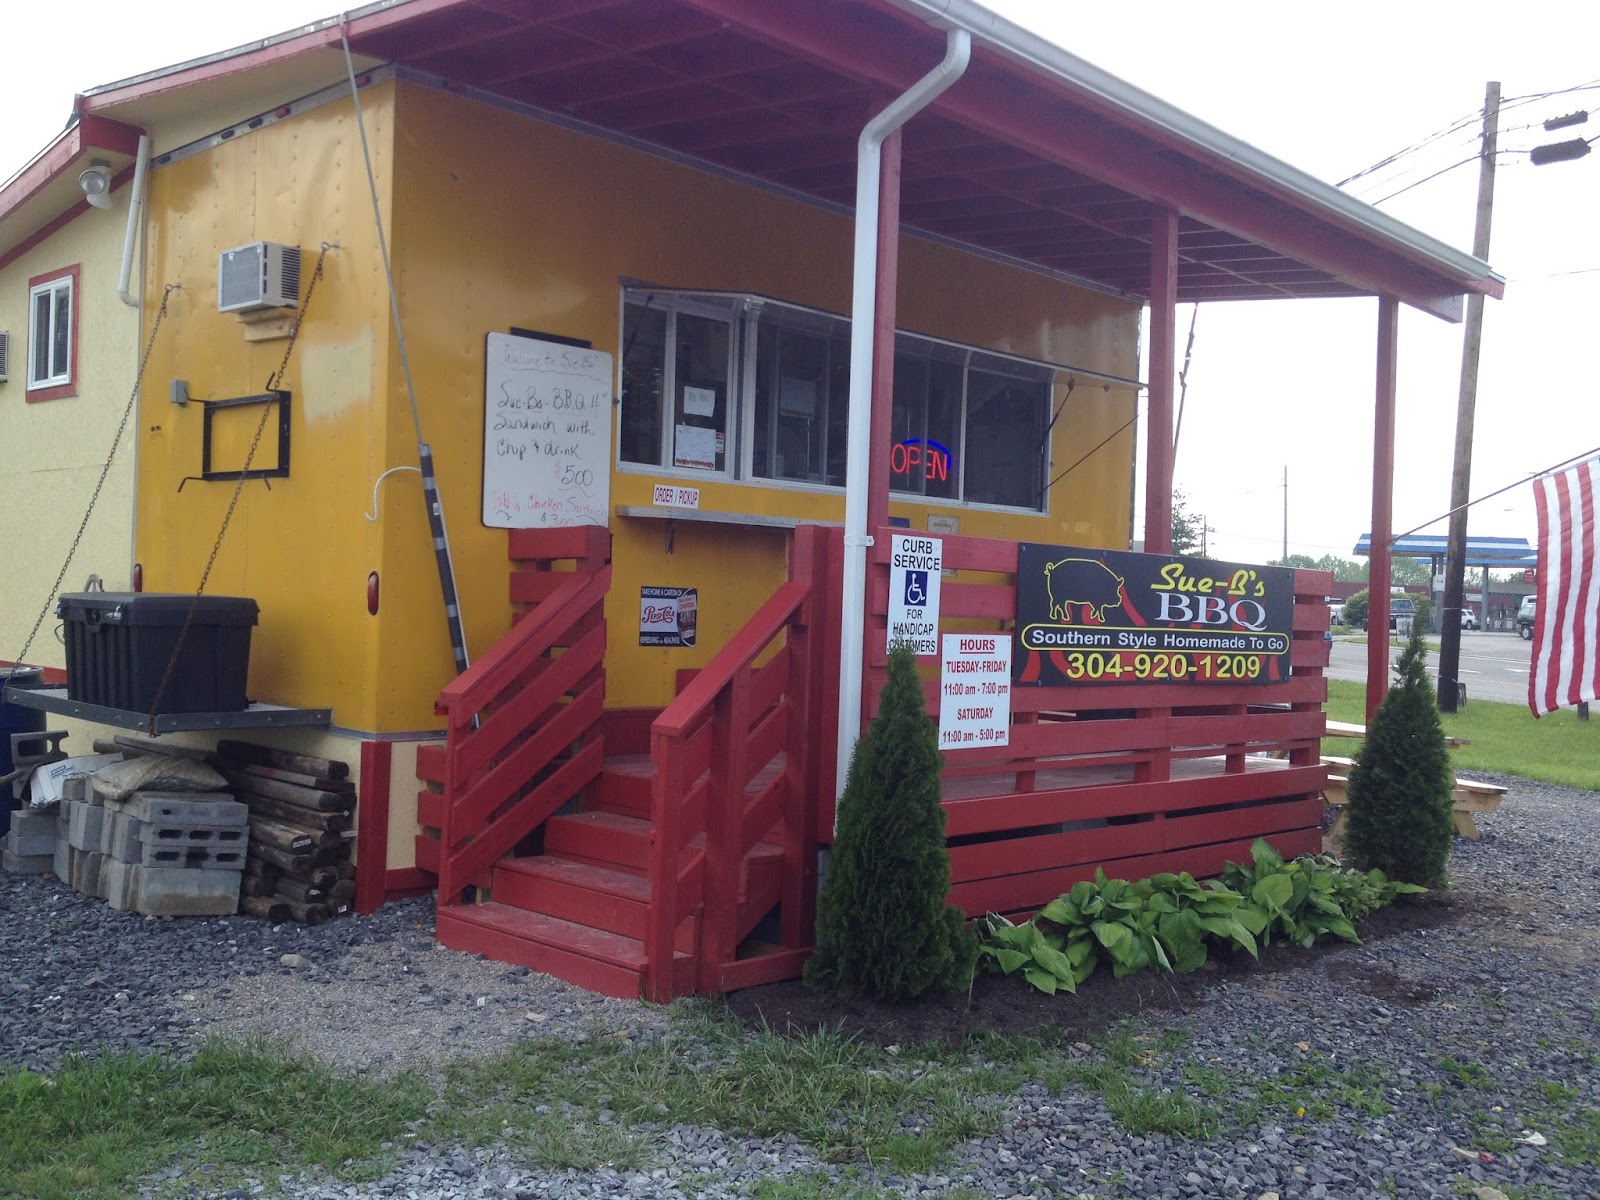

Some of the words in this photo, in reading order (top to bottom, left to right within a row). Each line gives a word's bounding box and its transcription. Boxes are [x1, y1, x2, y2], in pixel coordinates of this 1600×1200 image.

[494, 411, 557, 435] Sandwich
[567, 421, 596, 436] with
[891, 443, 948, 481] OPEN
[654, 487, 673, 503] ORDER
[679, 490, 698, 505] PICKUP
[902, 539, 933, 554] CURB
[894, 554, 940, 570] SERVICE
[1150, 563, 1265, 597] Sue-B's
[907, 609, 922, 619] FOR
[1154, 591, 1268, 632] BBQ
[893, 622, 934, 636] HANDICAP
[960, 639, 995, 651] HOURS
[1032, 629, 1111, 646] Southern
[1118, 632, 1157, 649] Style
[1164, 634, 1246, 649] Homemade
[1249, 637, 1263, 650] To
[1267, 637, 1284, 650] Go
[1066, 652, 1261, 679] 304-920-1209
[944, 683, 963, 695] 11:00
[965, 686, 976, 695] am
[982, 682, 996, 694] 7:00
[998, 685, 1008, 696] pm
[957, 707, 993, 720] SATURDAY
[943, 730, 962, 743] 11:00
[963, 733, 974, 741] am
[979, 729, 994, 740] 5:00
[995, 731, 1005, 742] pm
